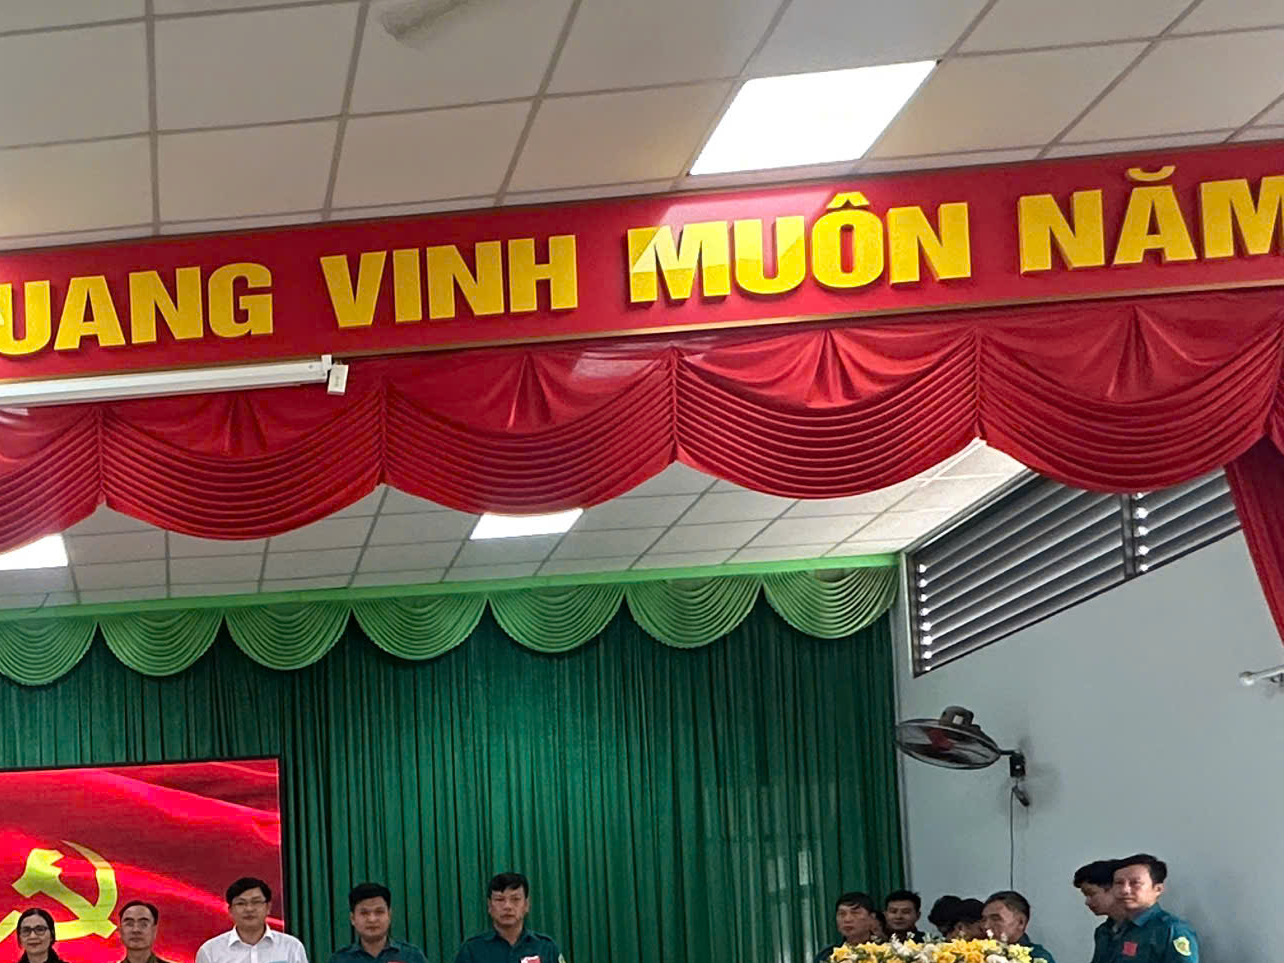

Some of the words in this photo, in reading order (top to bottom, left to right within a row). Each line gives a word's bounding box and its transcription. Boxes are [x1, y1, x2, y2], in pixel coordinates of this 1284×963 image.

[320, 235, 579, 328] VINH
[627, 191, 972, 304] MUÔN
[1019, 165, 1284, 274] NĂM
